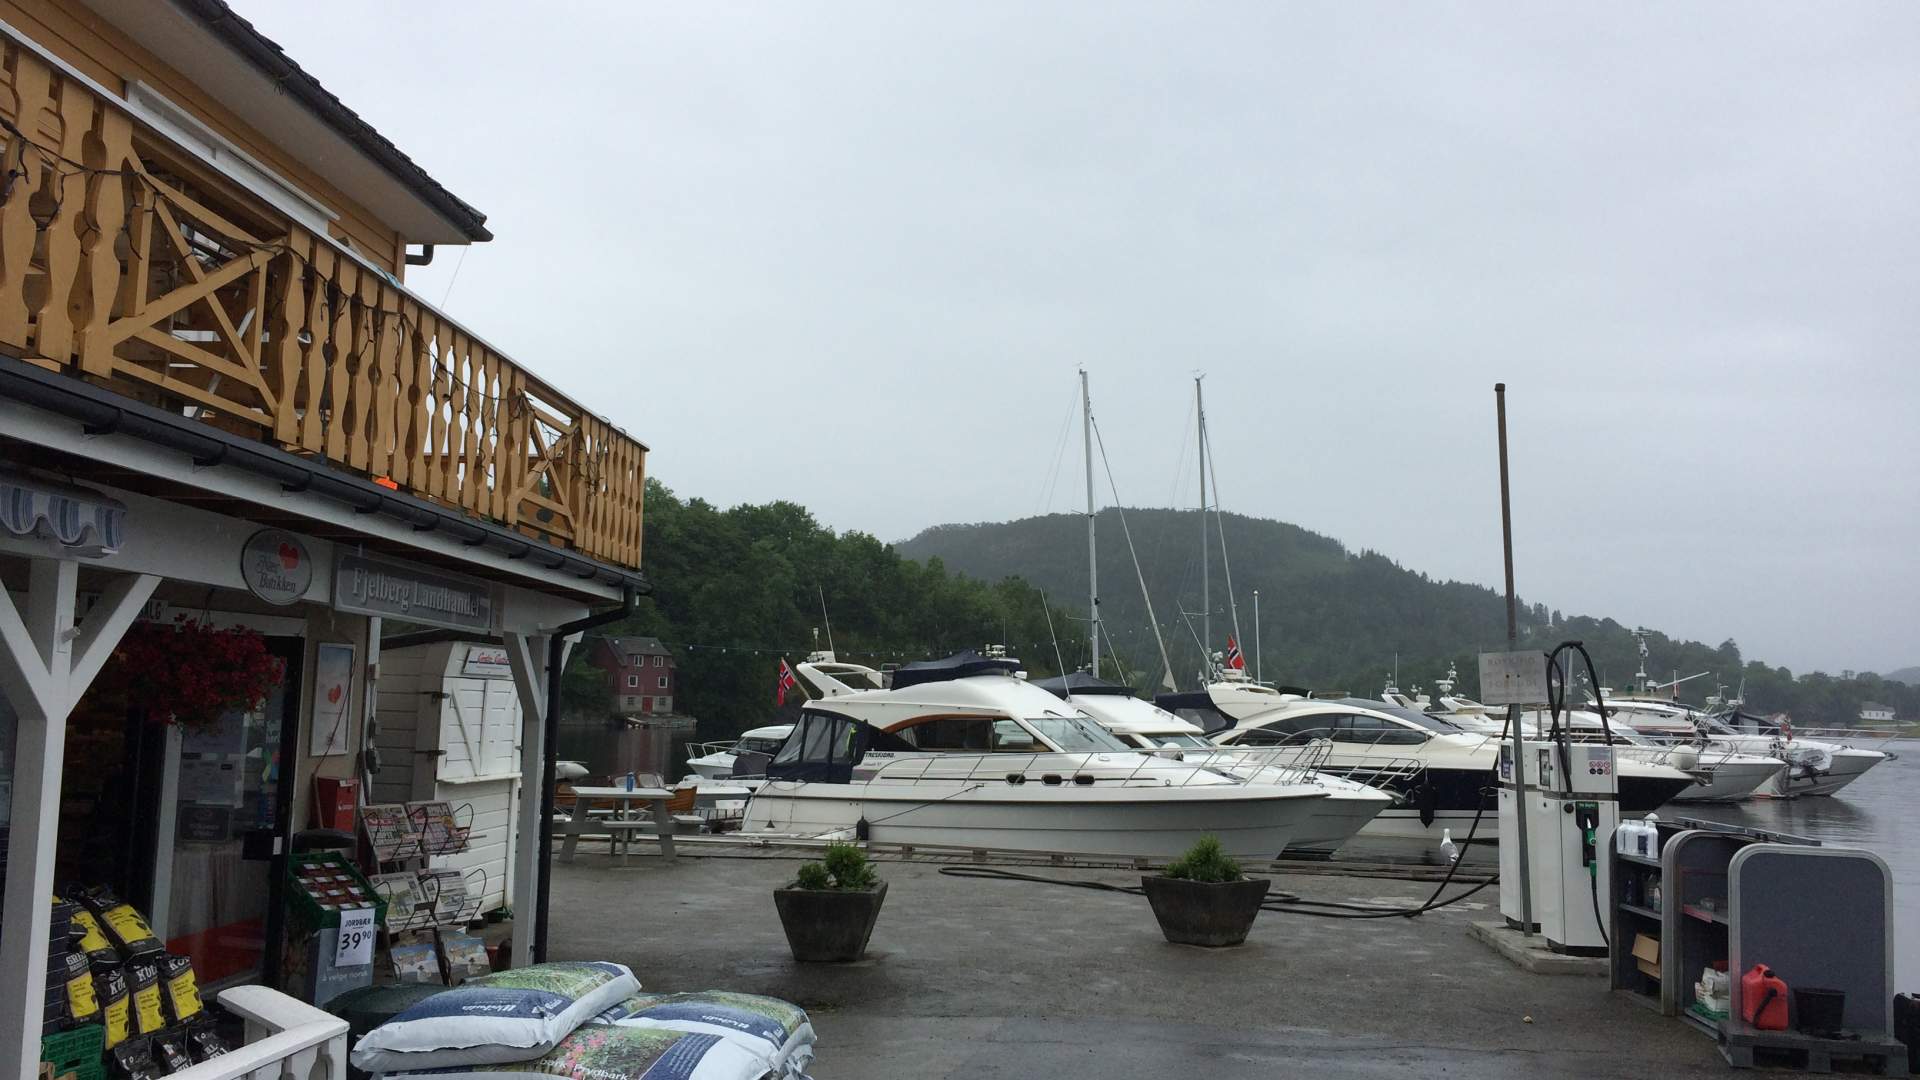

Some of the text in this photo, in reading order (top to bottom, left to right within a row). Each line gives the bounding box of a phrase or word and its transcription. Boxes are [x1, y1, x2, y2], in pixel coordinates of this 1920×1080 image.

[352, 567, 409, 613] Fjelberg
[341, 930, 372, 950] 39 90
